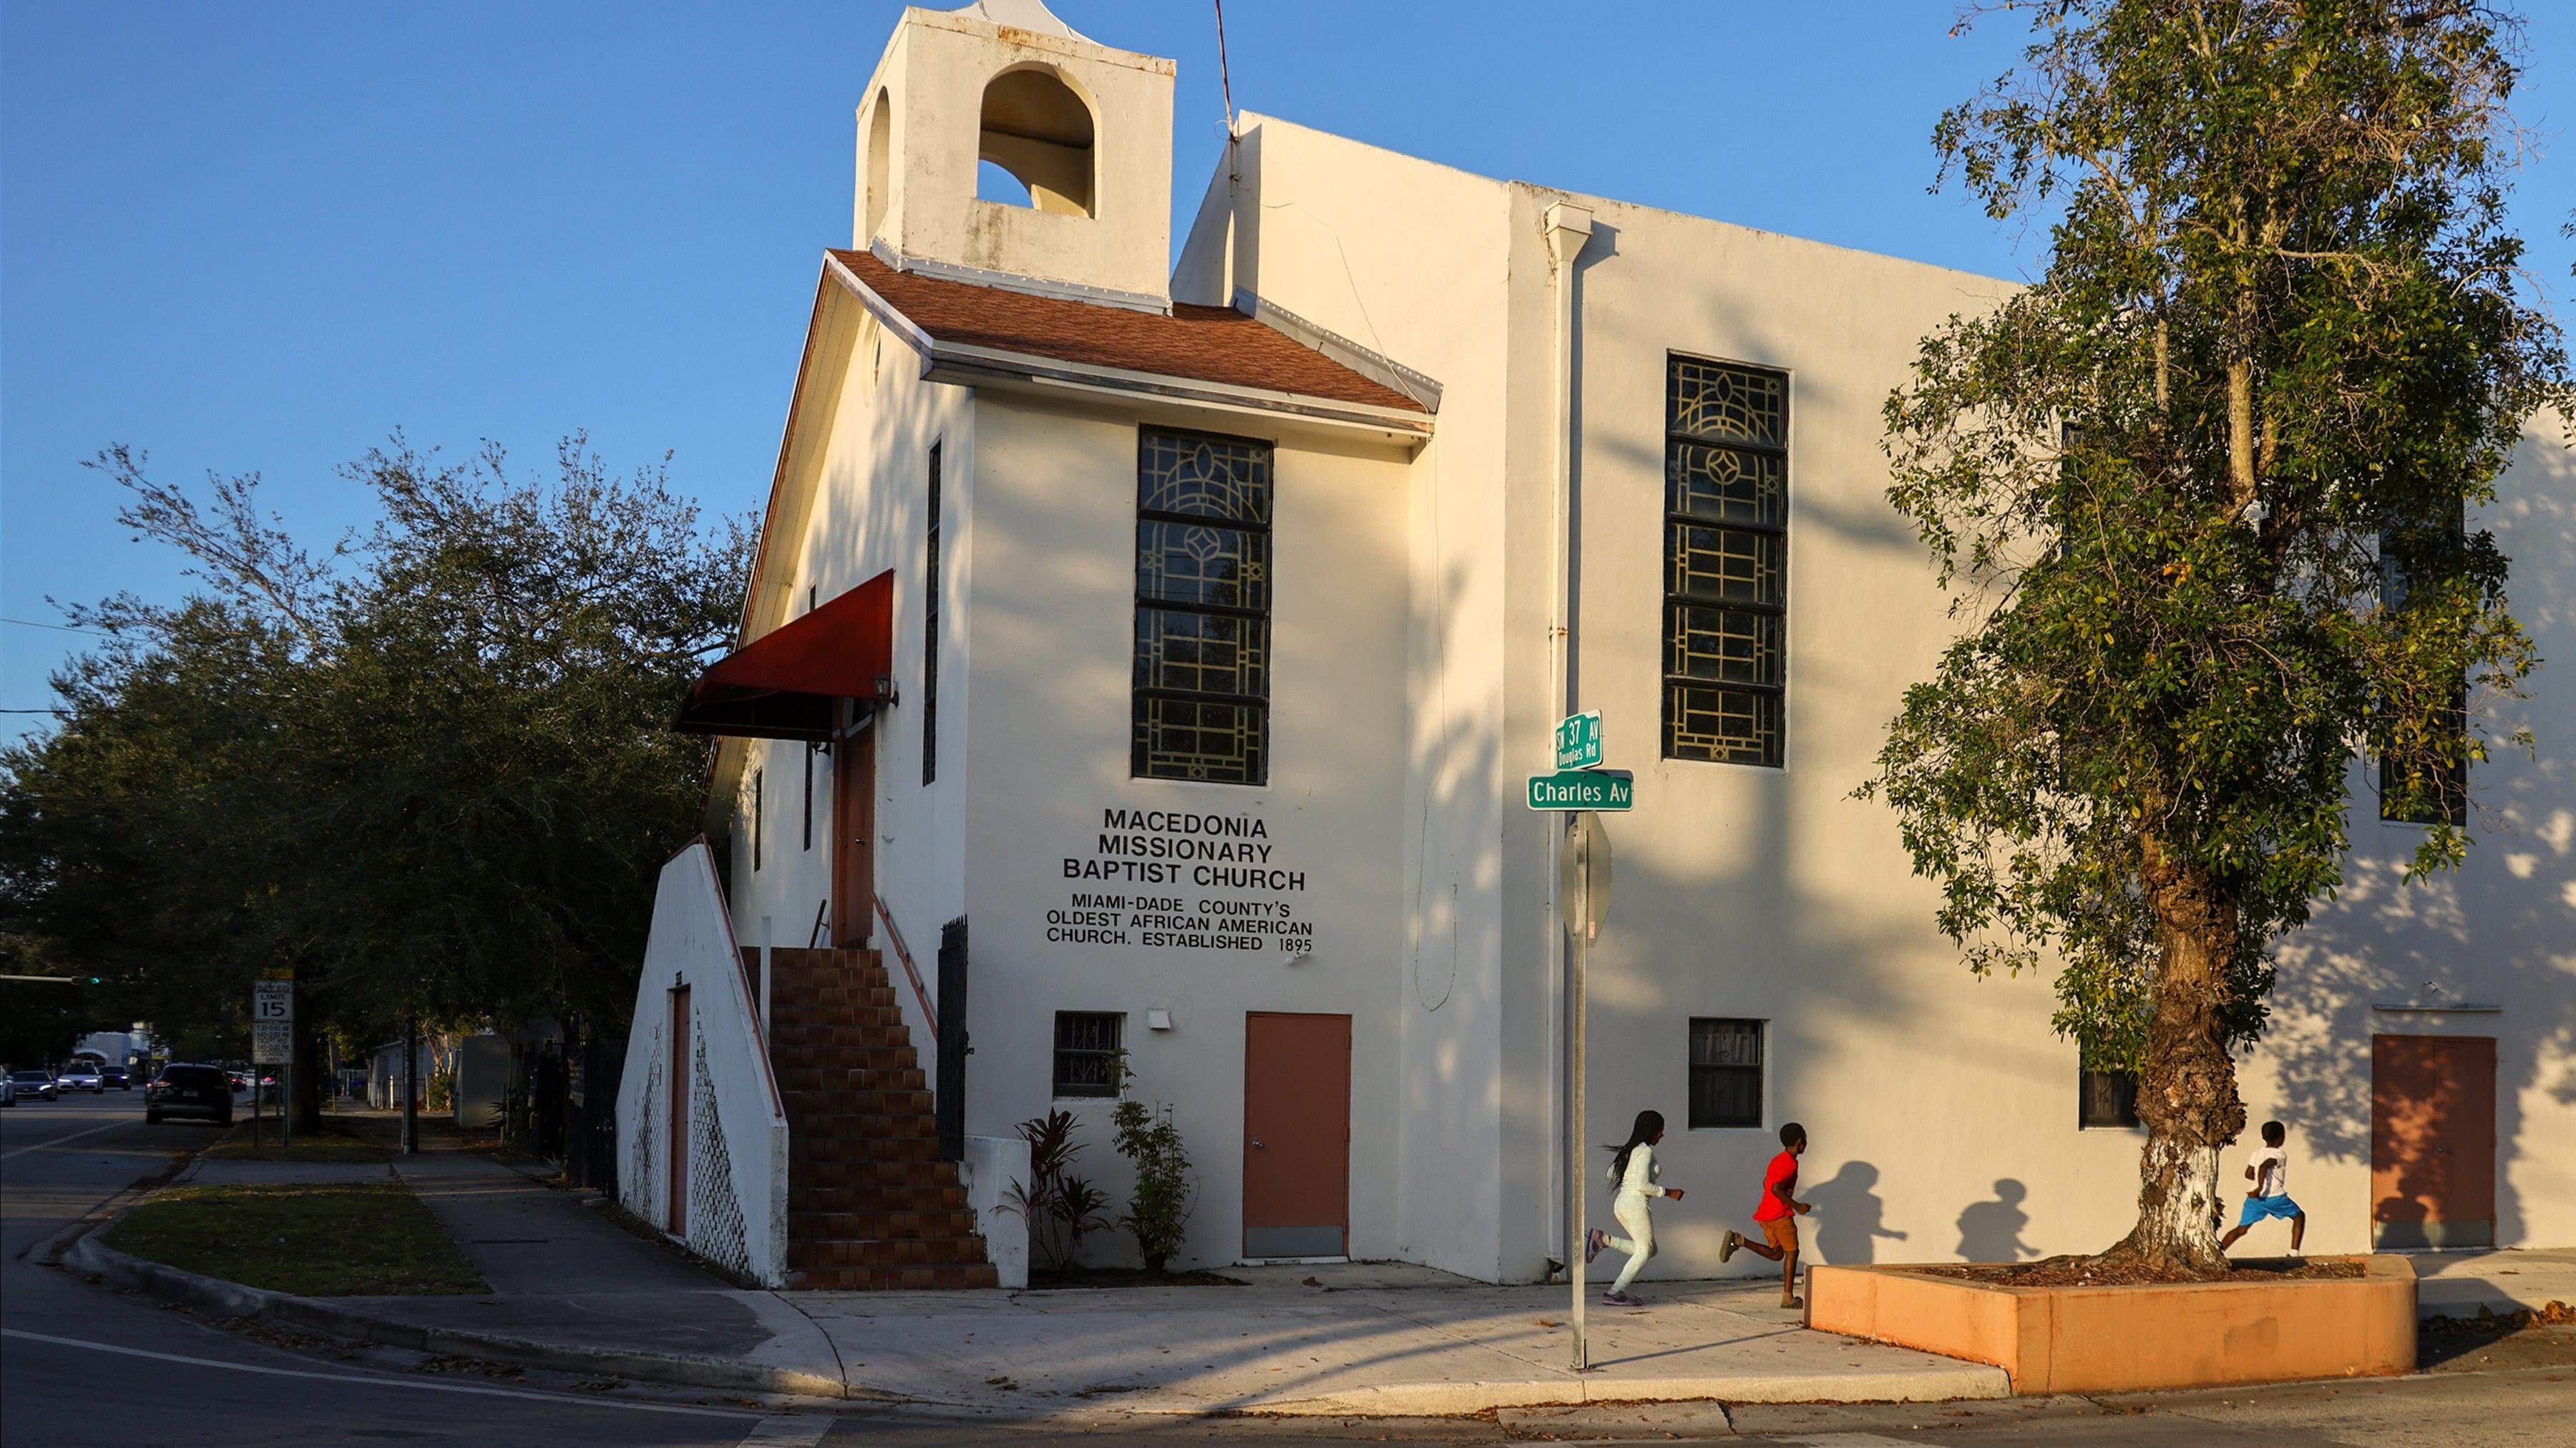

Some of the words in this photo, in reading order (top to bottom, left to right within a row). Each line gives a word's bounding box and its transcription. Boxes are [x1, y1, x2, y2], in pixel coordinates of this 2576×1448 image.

[1568, 719, 1581, 745] 37
[1589, 720, 1599, 741] AV
[1558, 748, 1583, 766] Douglas
[1586, 742, 1596, 758] Rd
[1533, 782, 1601, 801] Charles
[1609, 783, 1629, 802] Av
[1104, 808, 1268, 838] MACEDONIA
[1098, 834, 1272, 864] MISSIONARY
[1063, 858, 1181, 884] BAPTIST
[1193, 865, 1305, 891] CHURCH
[1072, 894, 1184, 912] MIAMI-DADE
[1199, 899, 1290, 917] COUNTY'S
[1047, 909, 1121, 927] OLDEST
[1131, 914, 1209, 931] AFRICAN
[1218, 919, 1312, 936] AMERICAN
[1047, 927, 1131, 945] CHURCH.
[1143, 932, 1263, 951] ESTABLISHED
[1279, 938, 1312, 954] 1895
[262, 1002, 286, 1017] 15
